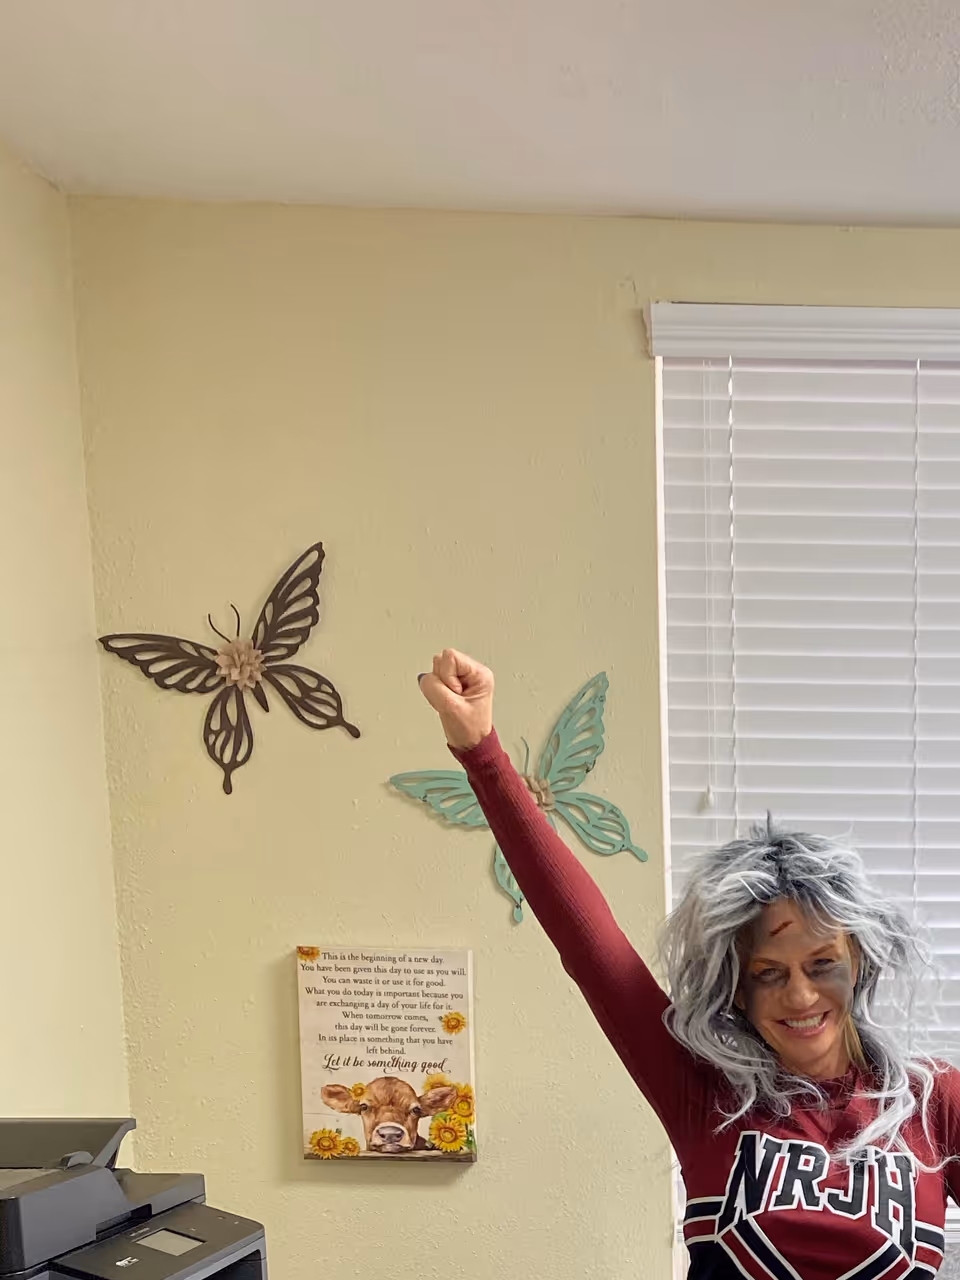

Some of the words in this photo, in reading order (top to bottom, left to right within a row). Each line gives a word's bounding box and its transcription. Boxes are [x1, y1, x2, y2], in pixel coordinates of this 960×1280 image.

[322, 952, 338, 960] This
[348, 952, 359, 960] the
[361, 953, 397, 964] beginning
[398, 954, 407, 962] of
[317, 963, 333, 971] have
[334, 964, 351, 972] been
[353, 966, 372, 974] given
[374, 965, 387, 973] this
[389, 966, 402, 976] day
[322, 976, 337, 984] You
[413, 978, 424, 986] for
[305, 987, 325, 995] What
[342, 988, 352, 996] do
[354, 988, 374, 998] today
[384, 990, 420, 999] important
[421, 990, 448, 998] because
[329, 999, 369, 1009] exchanging
[377, 1000, 389, 1009] day
[433, 1002, 444, 1010] for
[342, 1011, 364, 1019] When
[335, 1022, 348, 1030] this
[350, 1023, 362, 1032] day
[364, 1023, 379, 1031] will
[339, 1034, 357, 1043] place
[367, 1035, 405, 1045] something
[366, 1046, 378, 1054] left
[322, 1054, 340, 1070] Let
[343, 1056, 351, 1066] it
[353, 1056, 364, 1067] be
[367, 1055, 418, 1074] something
[420, 1058, 451, 1074] good
[716, 1131, 915, 1267] NRJH
